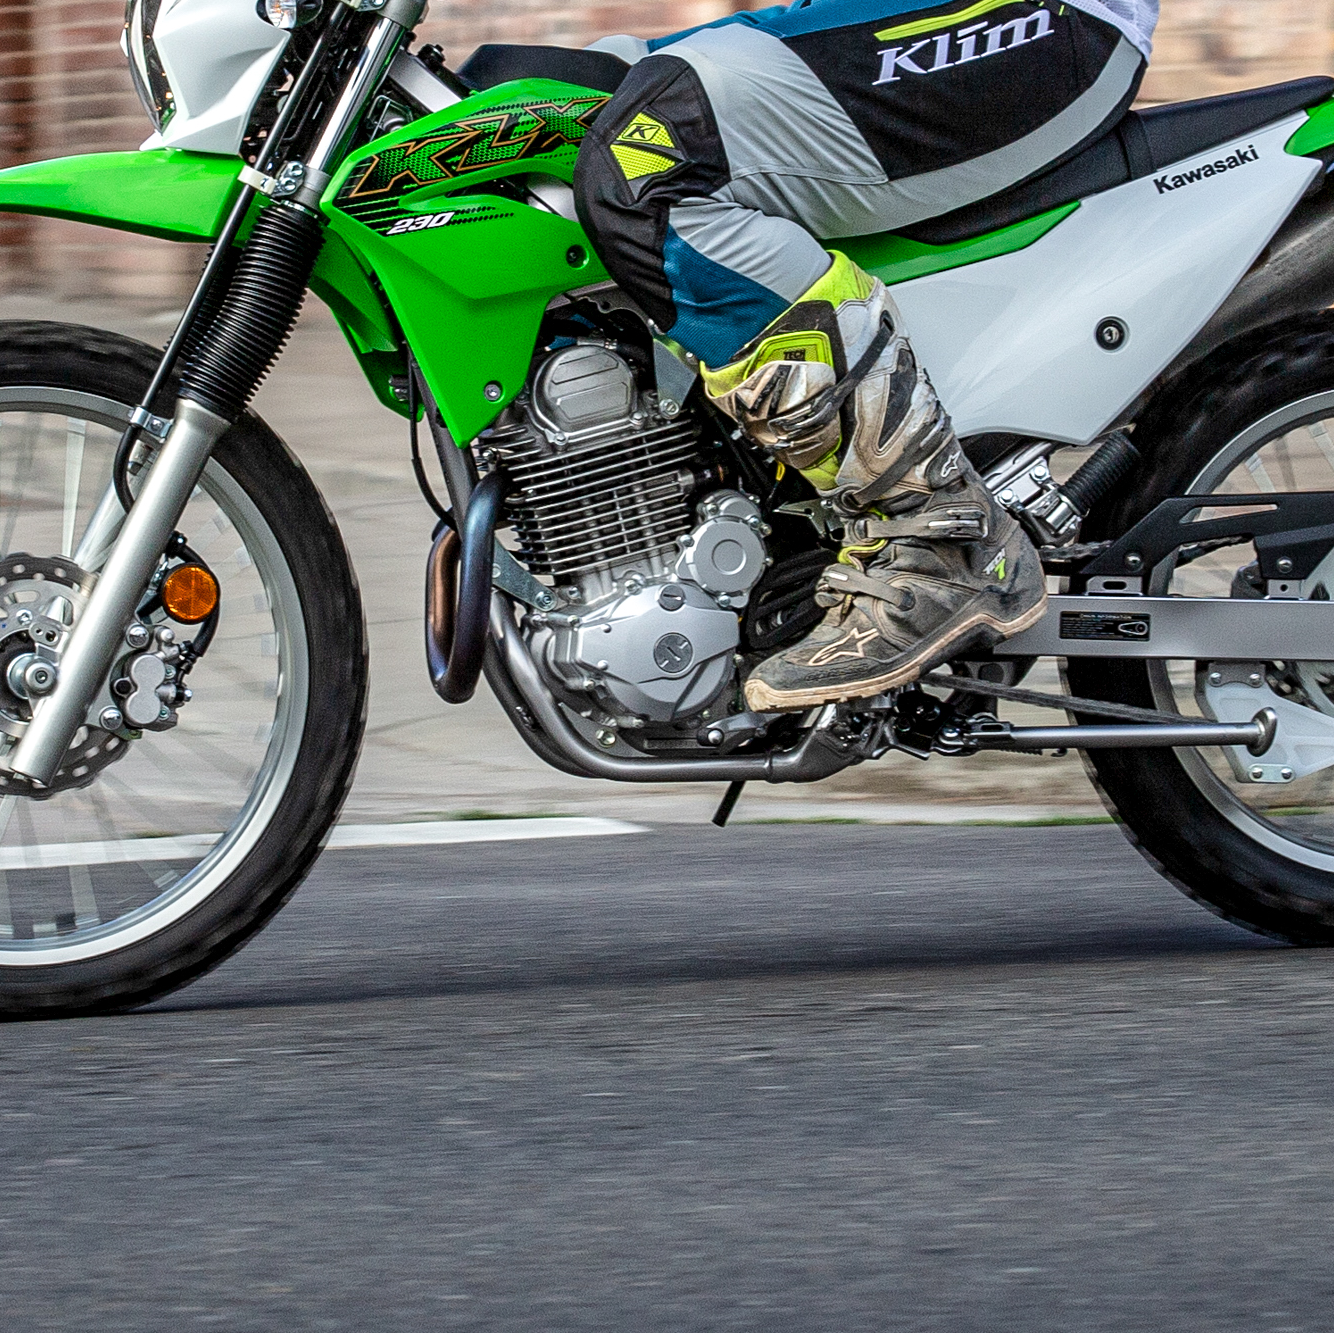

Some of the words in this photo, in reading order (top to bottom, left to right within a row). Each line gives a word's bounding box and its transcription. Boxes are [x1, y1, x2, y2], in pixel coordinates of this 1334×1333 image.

[348, 95, 612, 199] KLX
[1152, 144, 1260, 195] Kawasaki
[385, 211, 457, 236] 230
[994, 557, 1007, 580] 7
